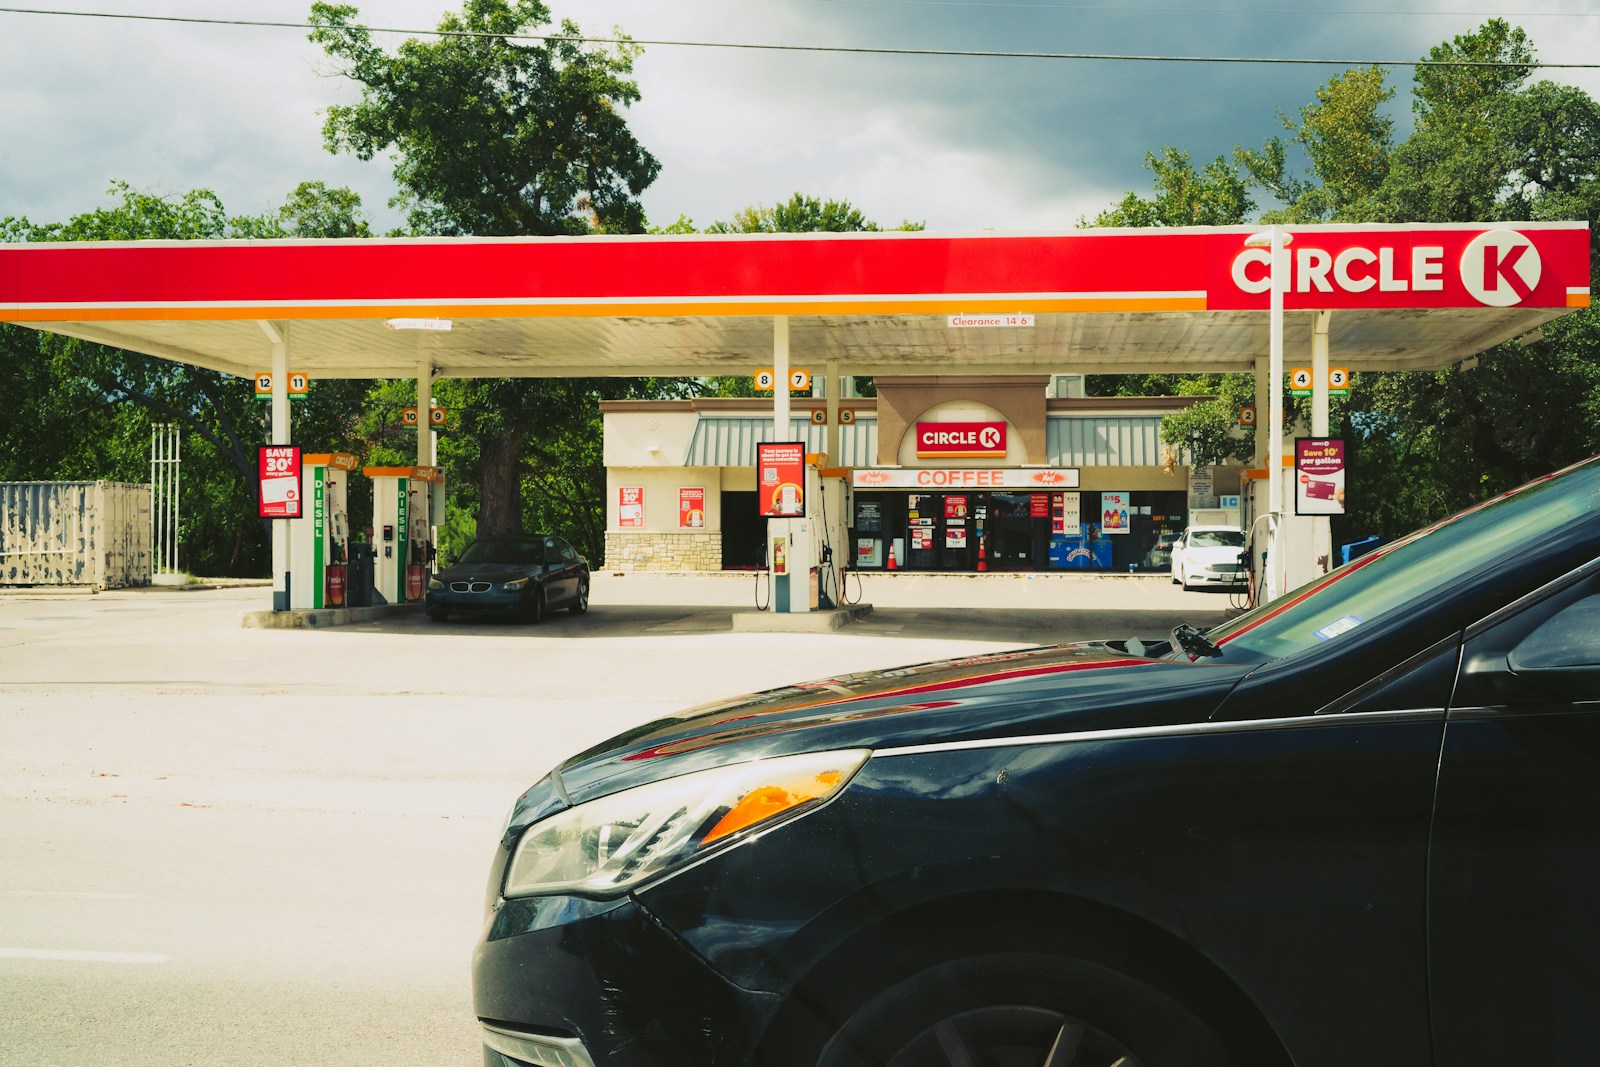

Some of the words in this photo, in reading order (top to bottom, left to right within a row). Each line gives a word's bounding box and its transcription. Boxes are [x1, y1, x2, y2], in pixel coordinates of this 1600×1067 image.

[1231, 246, 1444, 294] CIRCLE
[1480, 242, 1537, 301] K
[952, 317, 1001, 326] Clearance
[259, 378, 270, 388] 12
[293, 378, 303, 388] 11
[761, 375, 768, 384] 8
[795, 375, 802, 384] 7
[1297, 374, 1306, 384] 4
[1334, 373, 1341, 383] 3
[406, 413, 416, 421] 10
[435, 412, 441, 420] 9
[816, 413, 822, 421] 6
[1245, 412, 1251, 420] 2
[922, 431, 976, 445] CIRCLE
[983, 429, 998, 447] K
[265, 448, 293, 458] SAVE
[1303, 449, 1322, 457] Save
[266, 457, 293, 472] 30¢
[1300, 458, 1314, 466] per
[1315, 457, 1341, 466] gallon
[917, 470, 1004, 486] COFFEE
[314, 480, 323, 537] DIESEL
[398, 491, 406, 542] DIESEL
